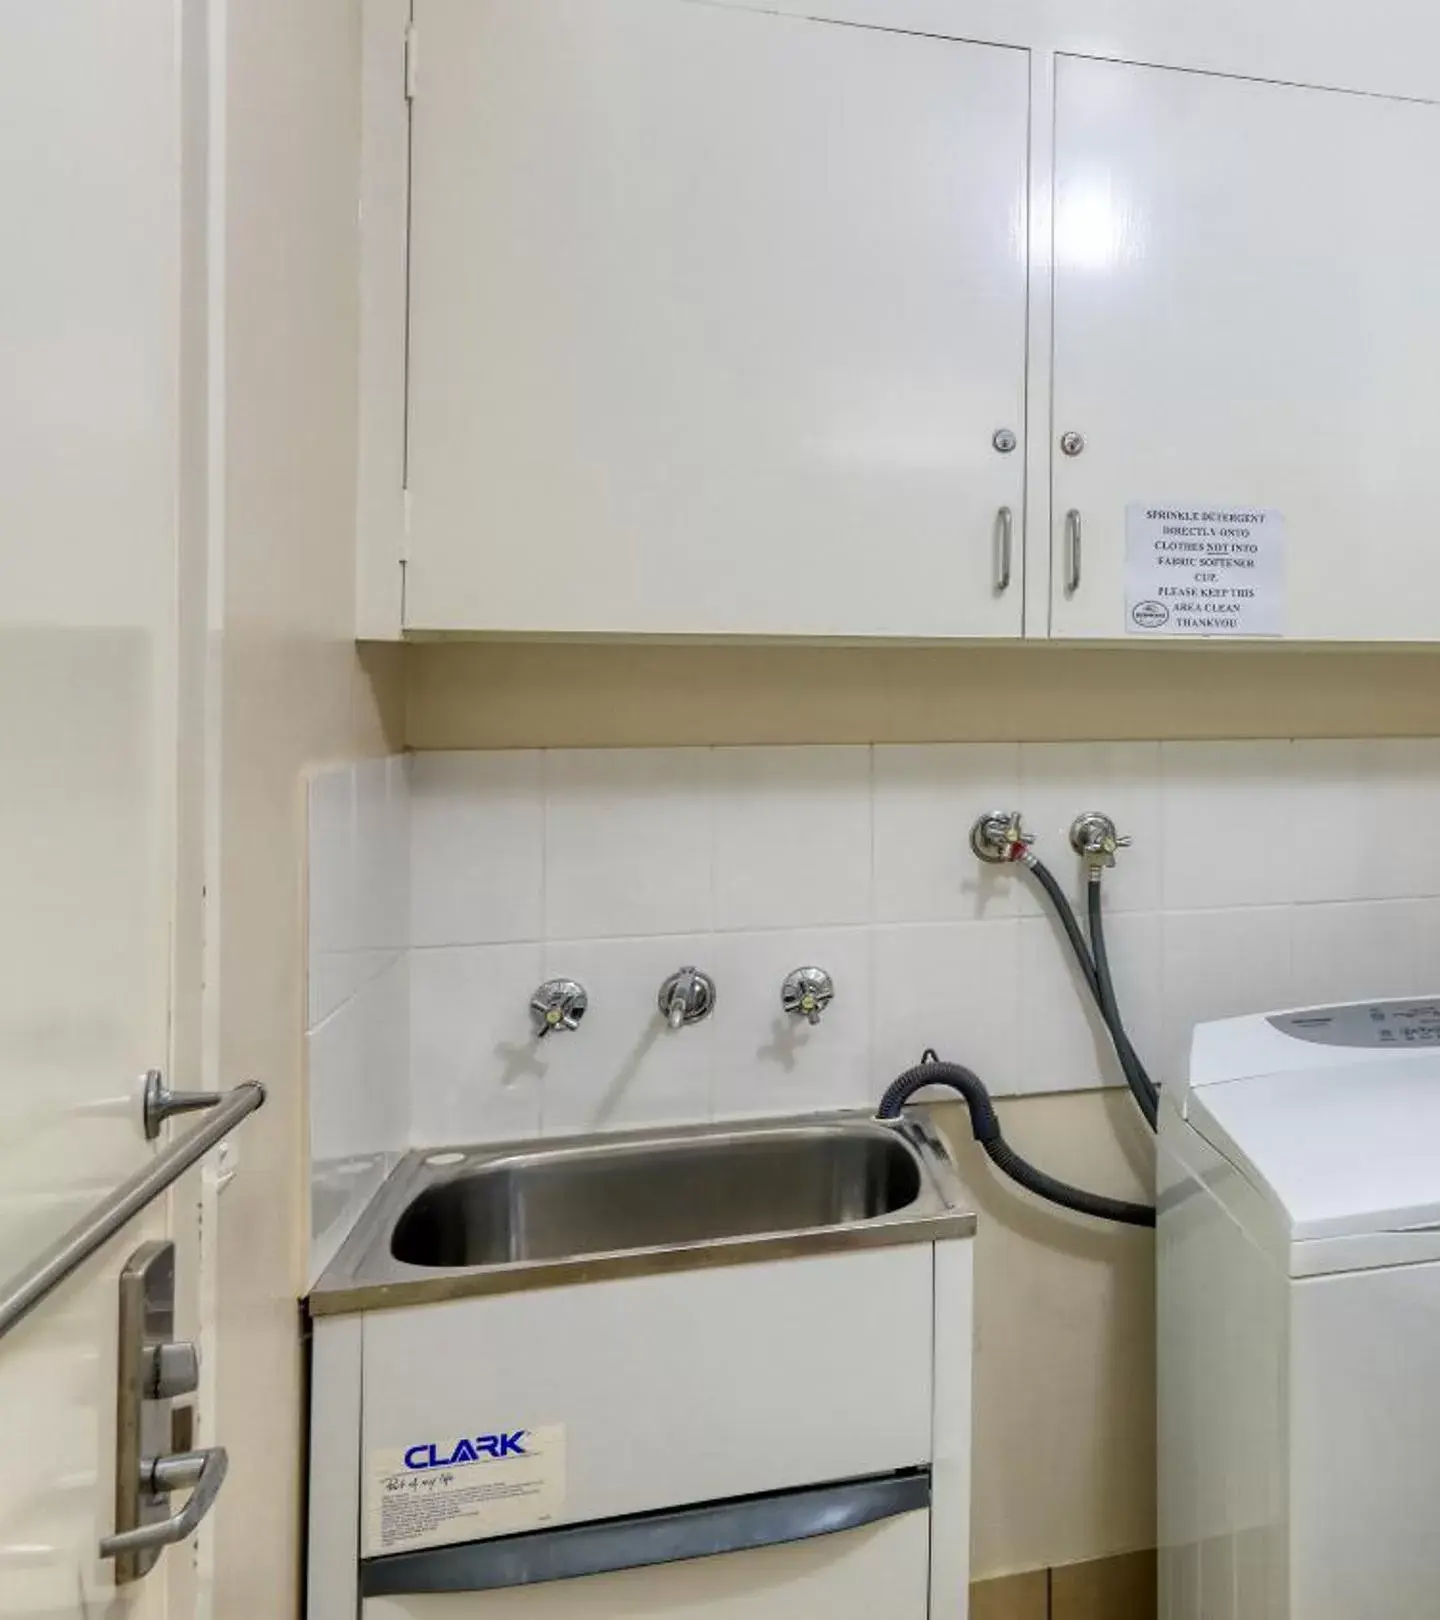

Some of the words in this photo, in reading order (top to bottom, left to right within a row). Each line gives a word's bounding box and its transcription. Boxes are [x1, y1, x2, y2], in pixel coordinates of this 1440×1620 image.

[1146, 510, 1199, 521] SPRINKLE
[1201, 513, 1266, 523] DETERGENT
[1162, 526, 1216, 537] DIRECTLY
[1220, 528, 1250, 538] ONTO
[1154, 541, 1204, 552] CLOTHES
[1206, 543, 1229, 555] NOT
[1231, 544, 1258, 553] INTO
[1158, 556, 1196, 567] FABRIC
[1199, 558, 1255, 568] SOFTENER
[1158, 587, 1197, 597] PLEASE
[1200, 588, 1229, 598] KEEP
[1231, 588, 1256, 598] THIS
[1173, 603, 1202, 612] AREA
[1205, 603, 1241, 613] CLEAN
[1176, 618, 1238, 628] THANKYOU
[404, 1429, 526, 1469] CLARK
